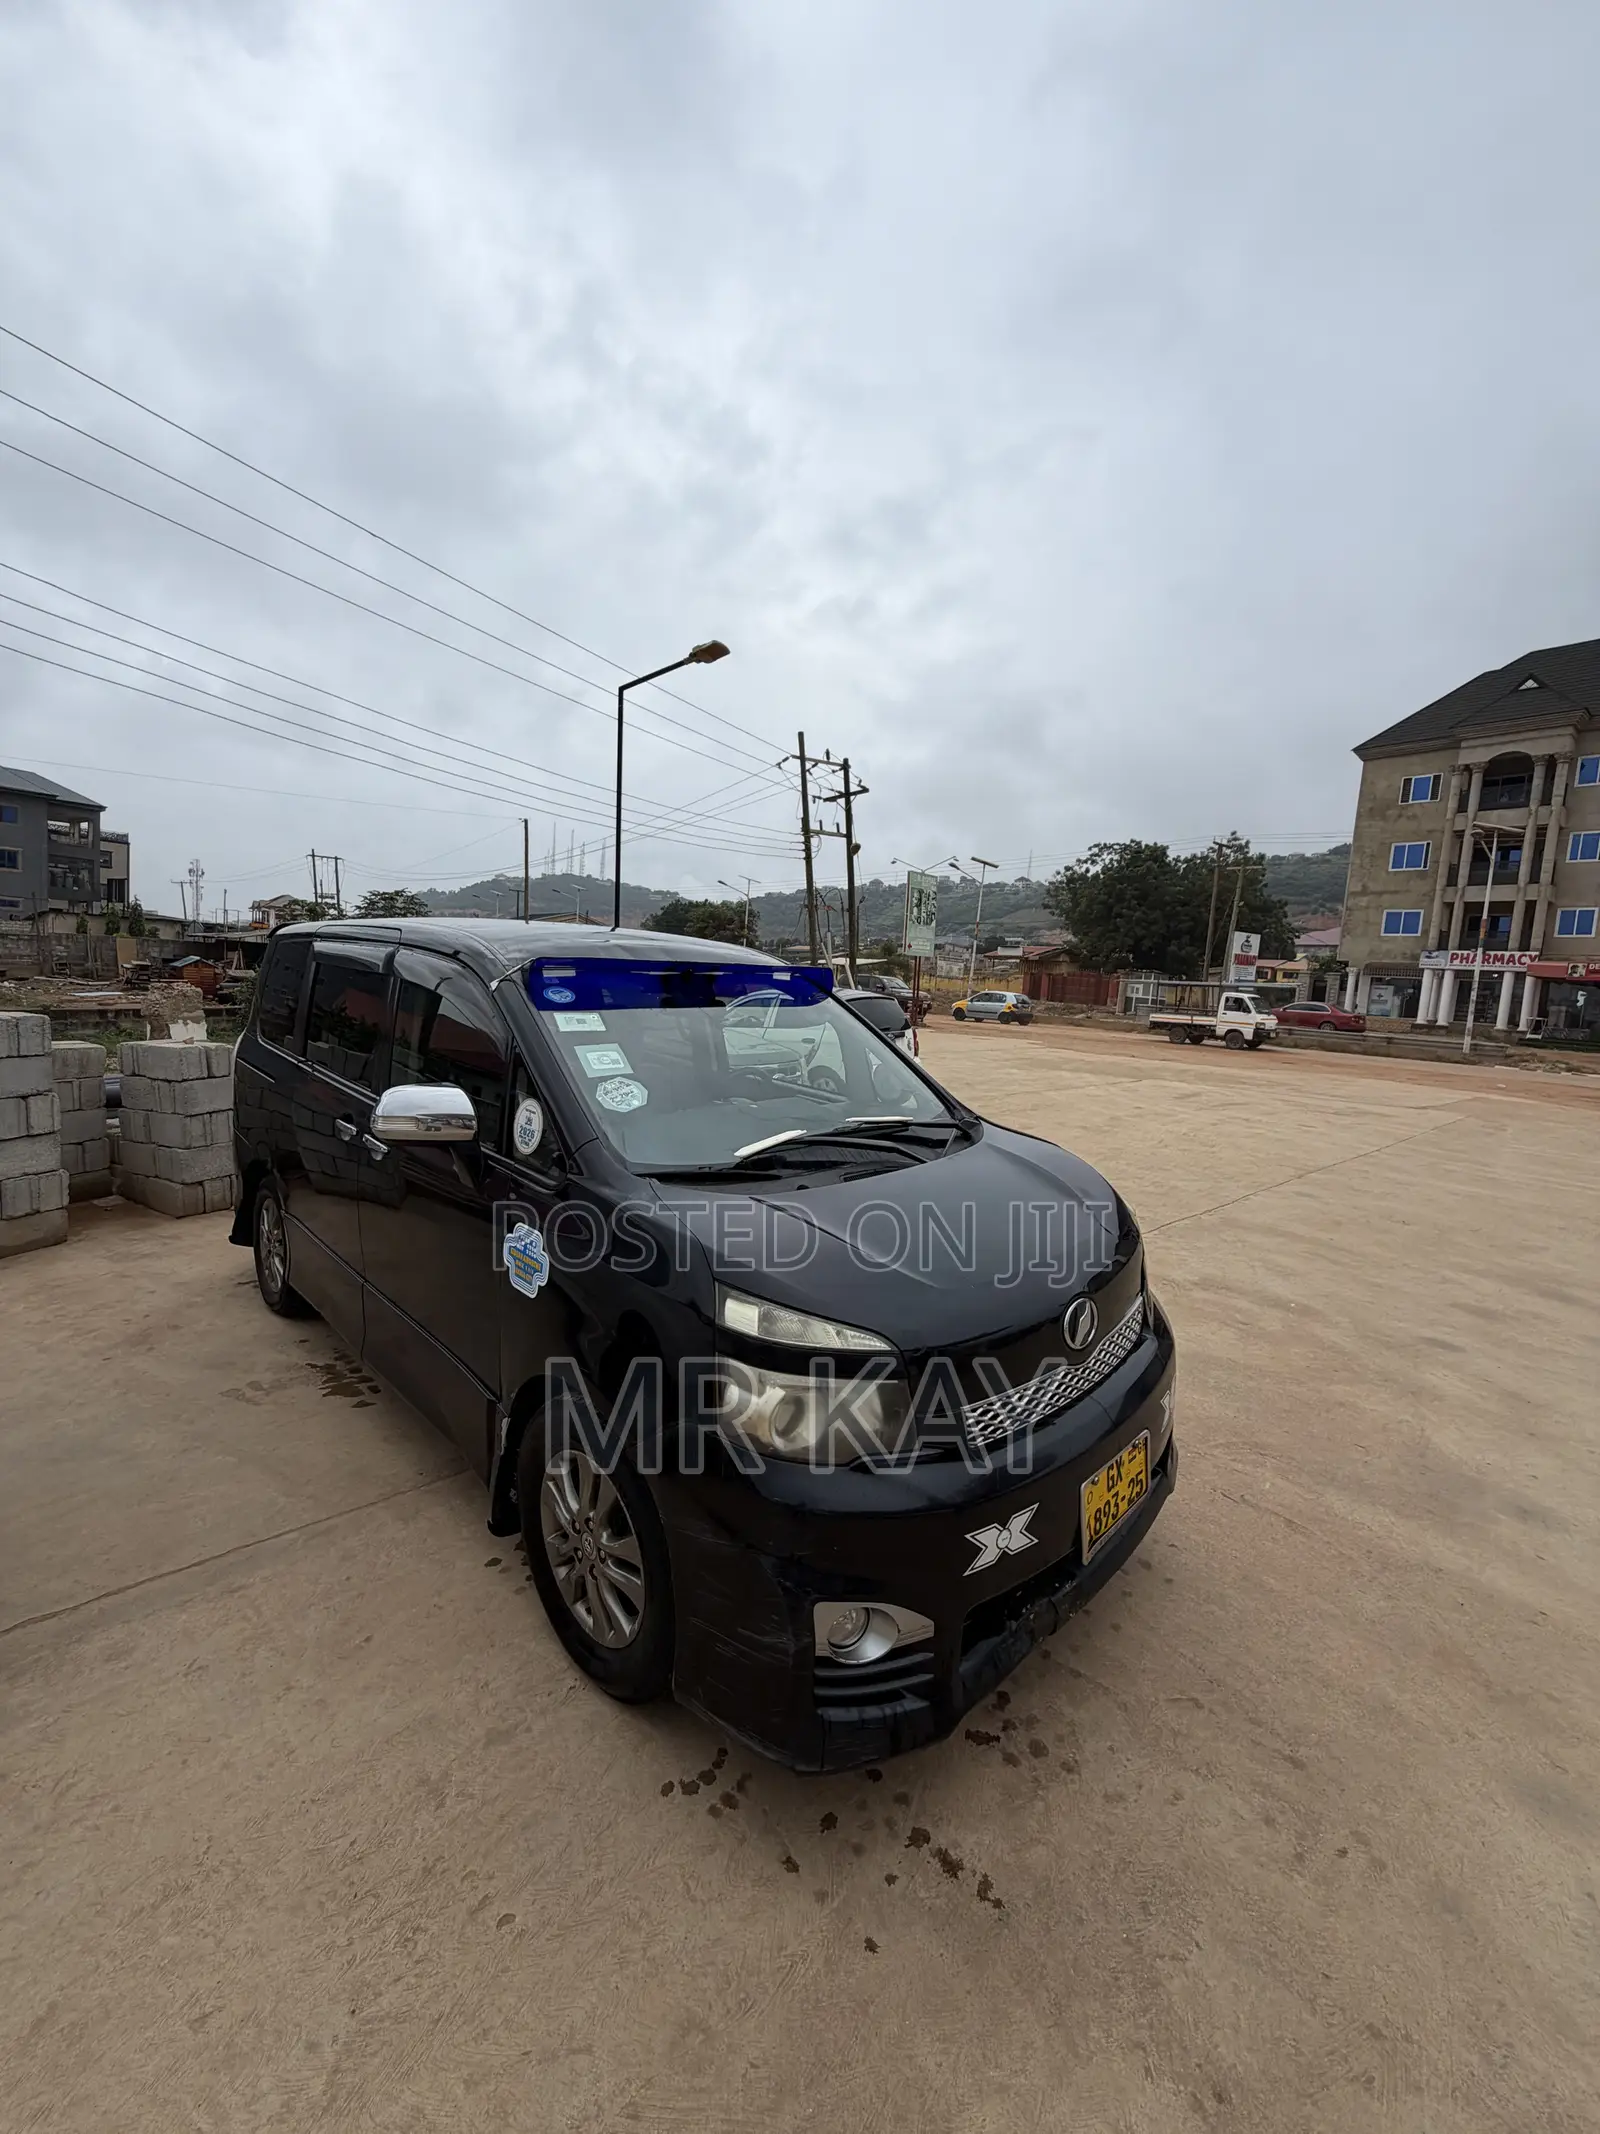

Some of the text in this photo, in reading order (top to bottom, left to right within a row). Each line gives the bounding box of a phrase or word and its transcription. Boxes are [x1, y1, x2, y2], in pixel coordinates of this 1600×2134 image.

[1449, 952, 1539, 966] PHARMACY
[1107, 1456, 1125, 1493] GX
[1087, 1469, 1143, 1547] 1893-25
